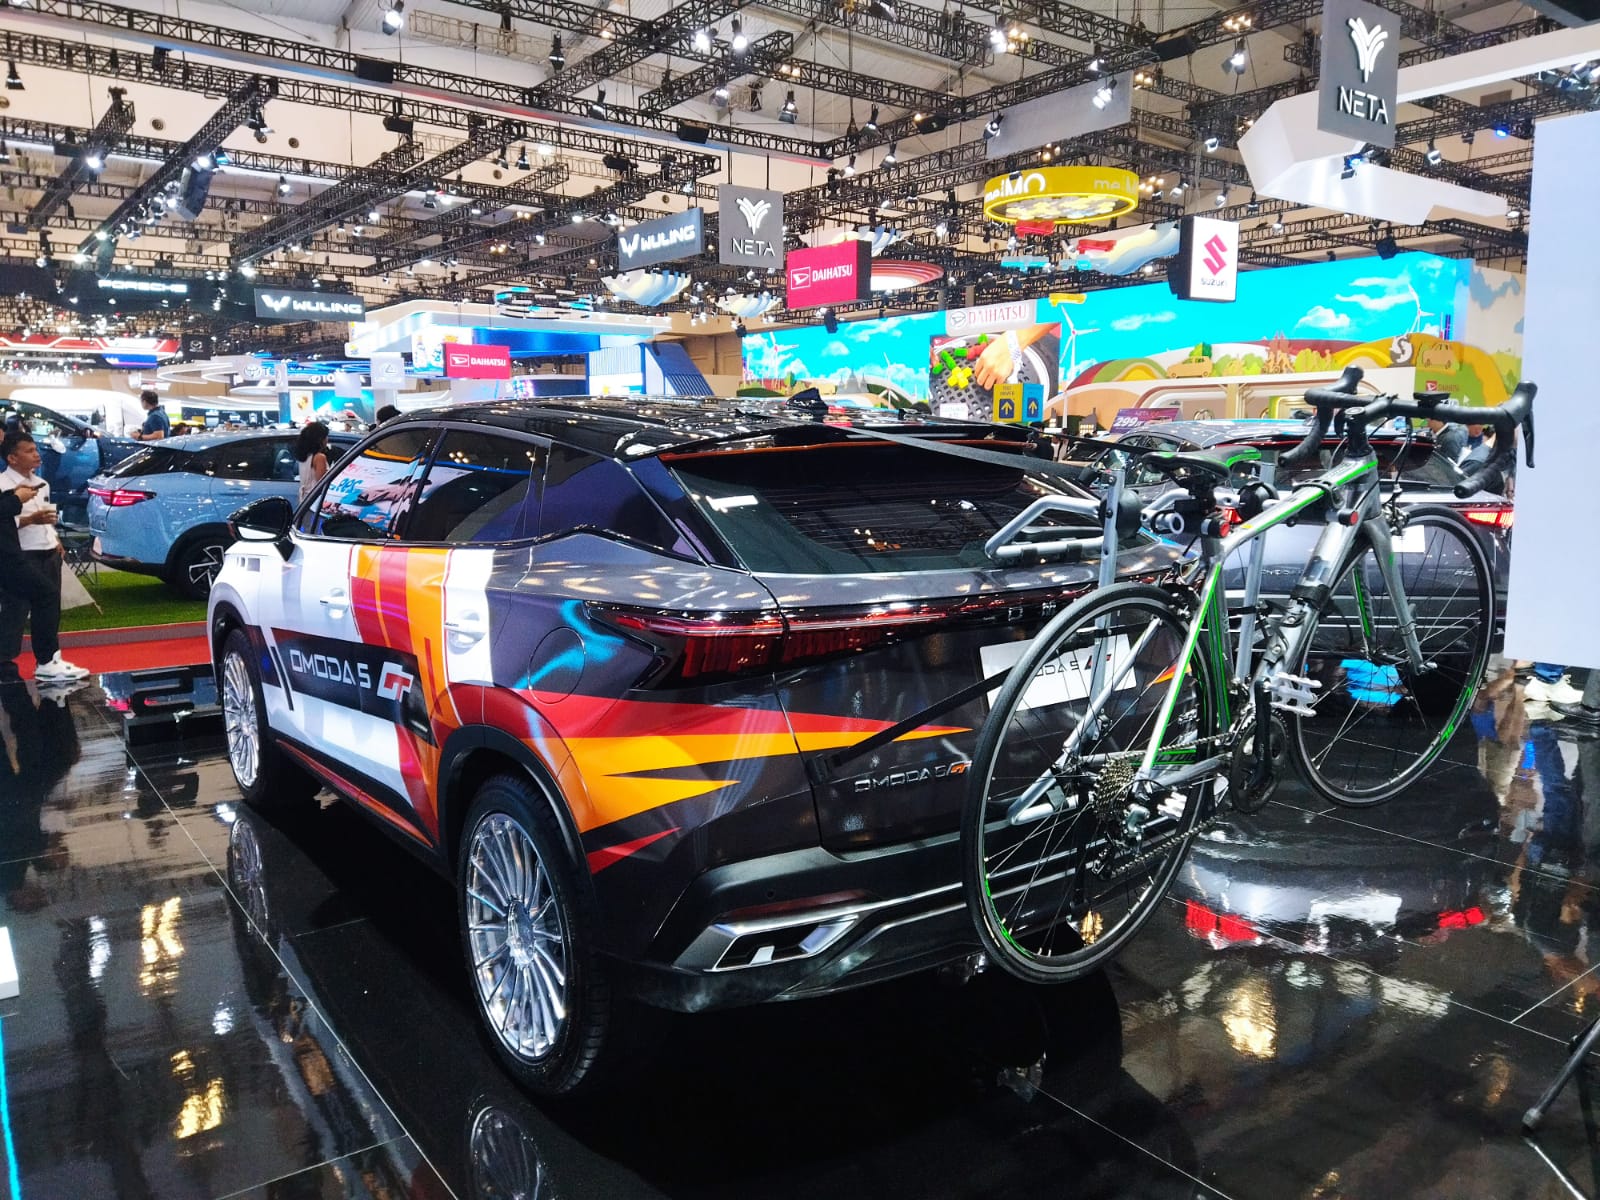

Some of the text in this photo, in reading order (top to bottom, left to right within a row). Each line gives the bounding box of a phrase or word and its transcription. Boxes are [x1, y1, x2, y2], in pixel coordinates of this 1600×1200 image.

[1337, 85, 1389, 125] NETA
[640, 225, 696, 251] WULING
[732, 238, 776, 257] NETA
[812, 264, 853, 283] DAIHATSU
[98, 280, 188, 293] PORSCHE
[292, 299, 363, 314] WULING
[968, 304, 1028, 324] DAIHATSU
[470, 356, 507, 367] DAIHATSU
[1113, 416, 1139, 427] 299
[289, 649, 356, 686] OMODA
[854, 768, 931, 793] OMODA
